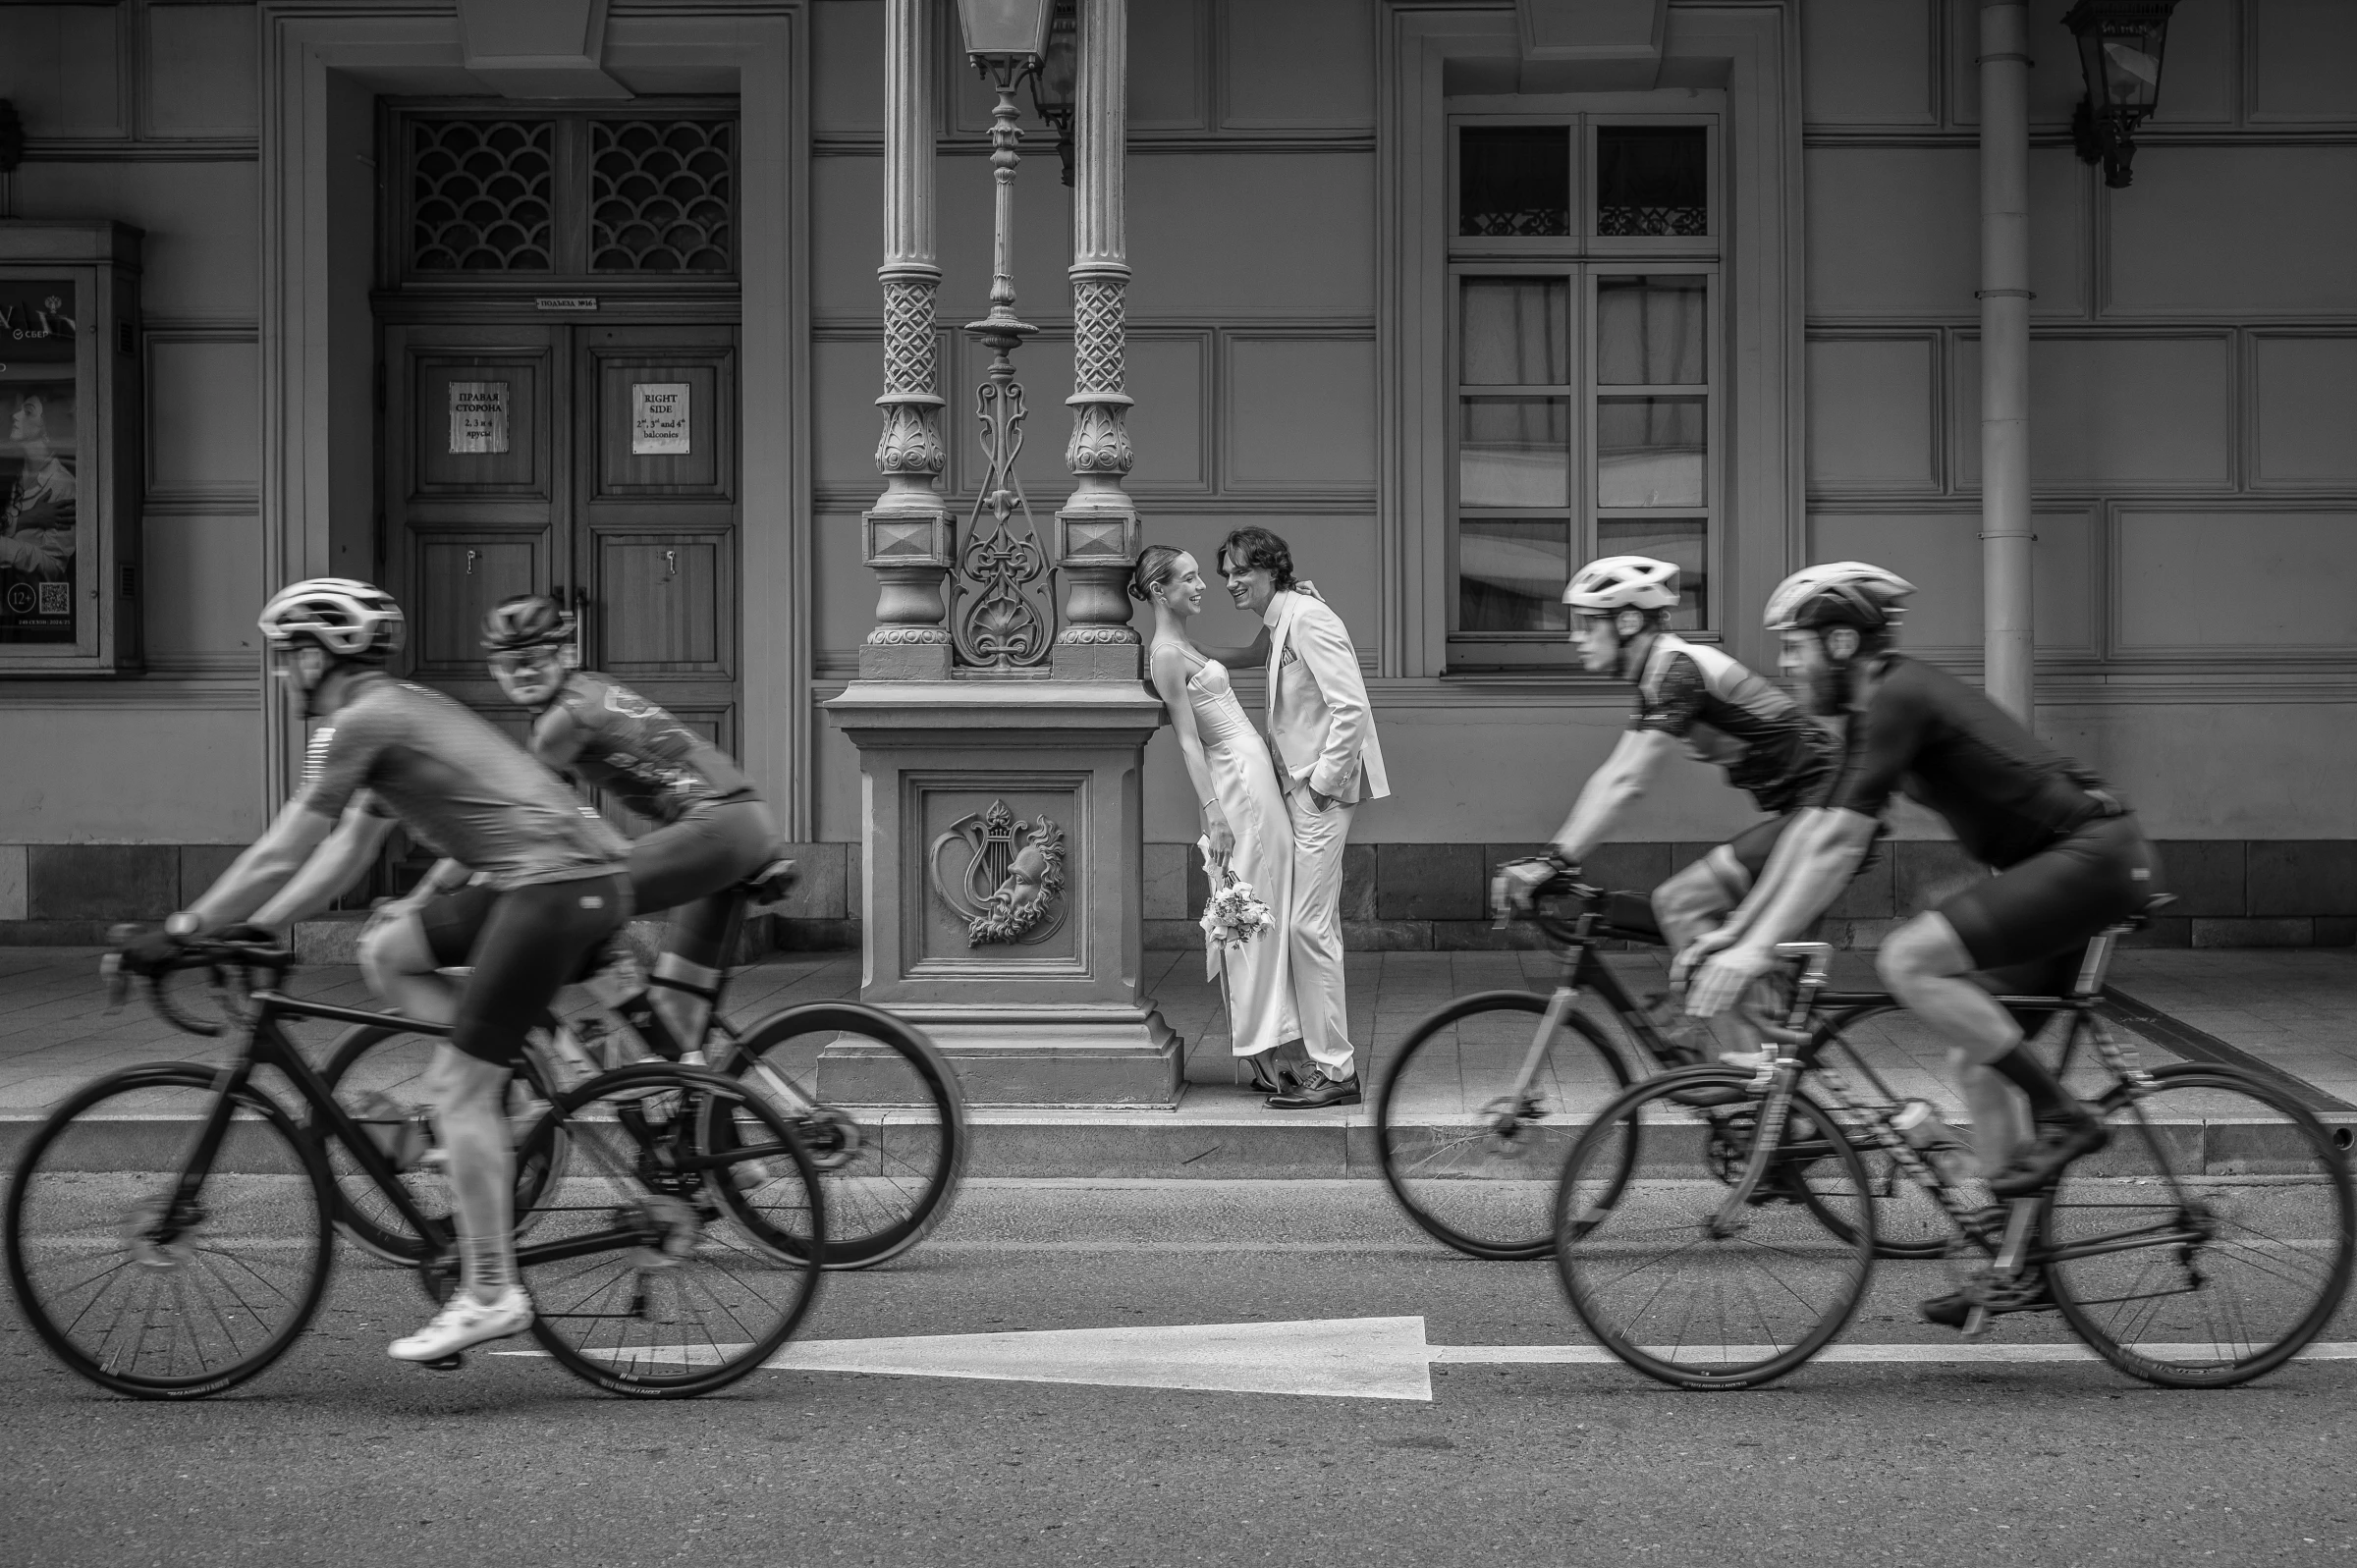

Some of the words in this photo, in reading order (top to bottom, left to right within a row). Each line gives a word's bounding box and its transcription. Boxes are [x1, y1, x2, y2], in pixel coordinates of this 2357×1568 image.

[459, 393, 500, 402] ПРАВАЯ
[644, 394, 678, 403] RIGHT
[456, 404, 502, 412] СТОРОНА
[649, 405, 673, 413] SIDE
[465, 418, 472, 427] 2,
[474, 418, 479, 427] 3
[487, 418, 493, 427] 4
[660, 419, 675, 428] and
[643, 430, 679, 439] balconies
[13, 591, 31, 605] 12+
